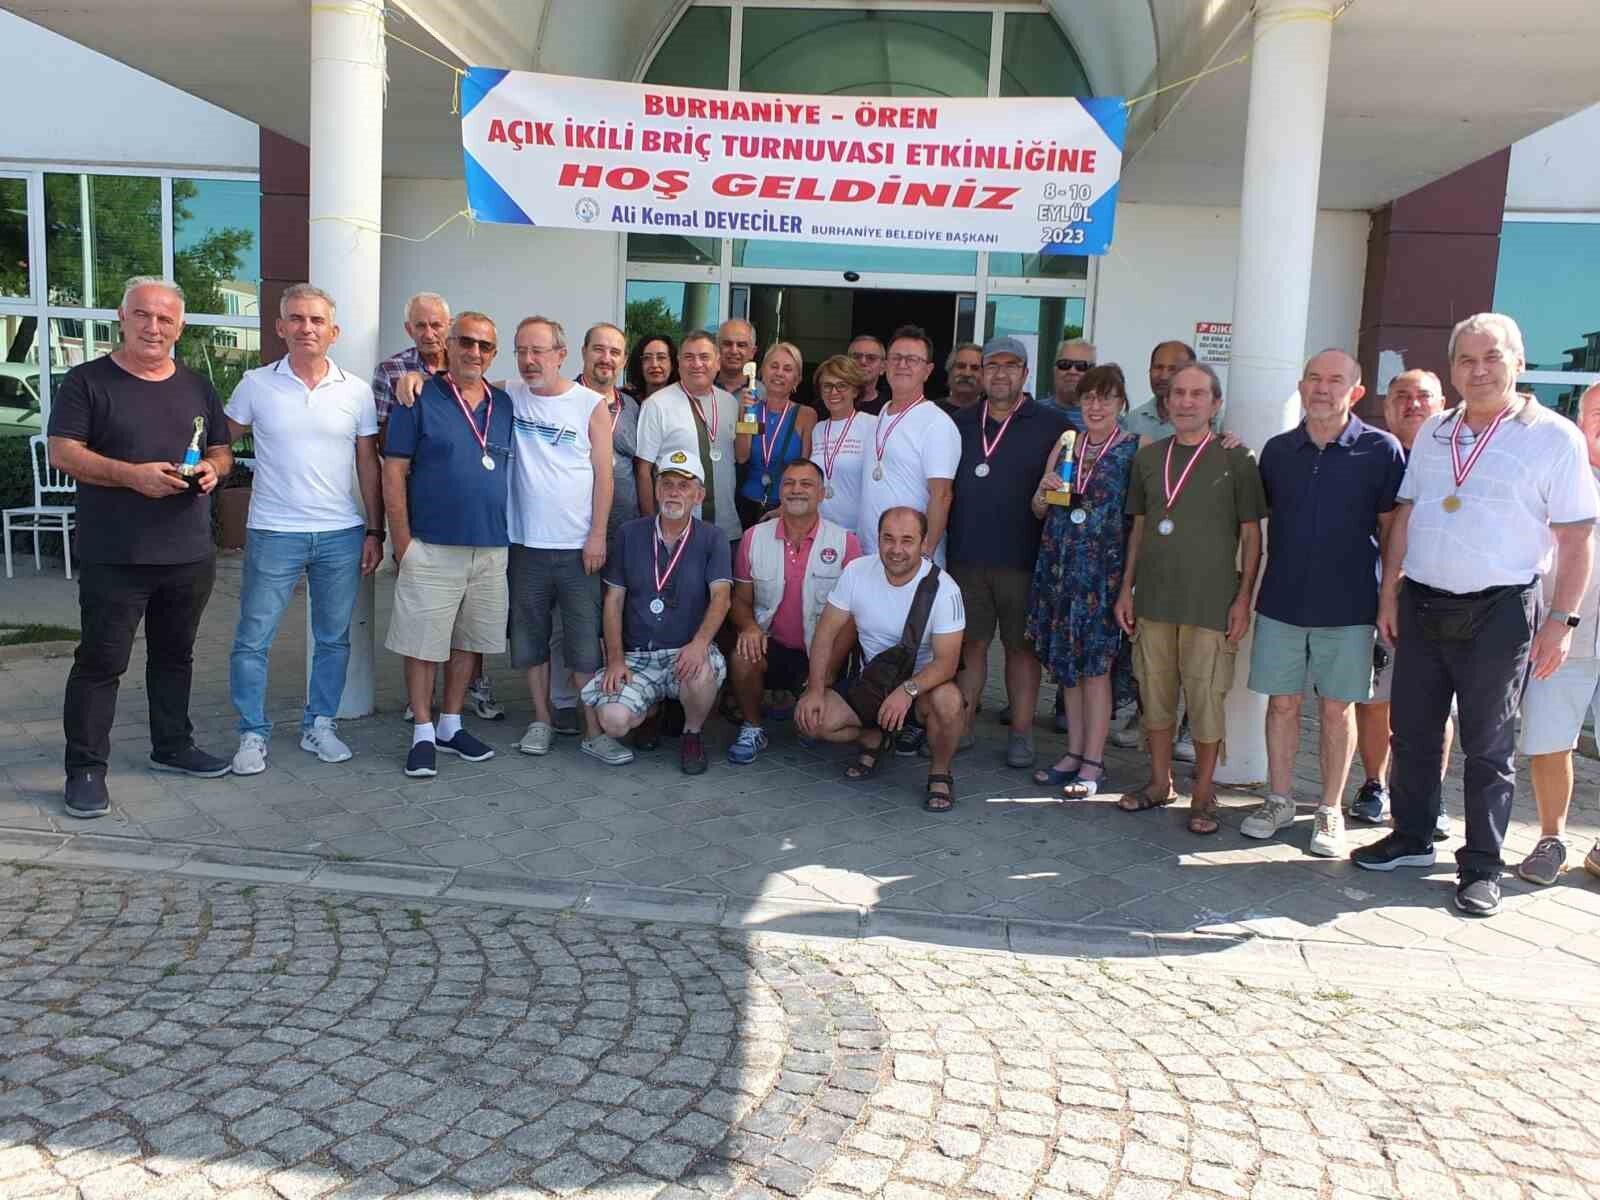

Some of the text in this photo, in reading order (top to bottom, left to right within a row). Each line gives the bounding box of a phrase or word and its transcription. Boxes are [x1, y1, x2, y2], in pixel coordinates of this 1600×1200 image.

[644, 94, 820, 125] BURHANİYE
[855, 102, 938, 129] ÖREN
[488, 117, 1096, 173] AÇIK İKİLİ BRİÇ TURNUVASI ETKİNLİĞİNE
[559, 164, 1022, 210] HOŞ GELDİNİZ
[611, 205, 802, 233] Ali Kemal DEVECİLER
[1038, 201, 1093, 224] EYLÜL
[811, 225, 999, 244] BURHANİYE BELEDİYE BAŞKANI
[1040, 227, 1085, 244] 2023
